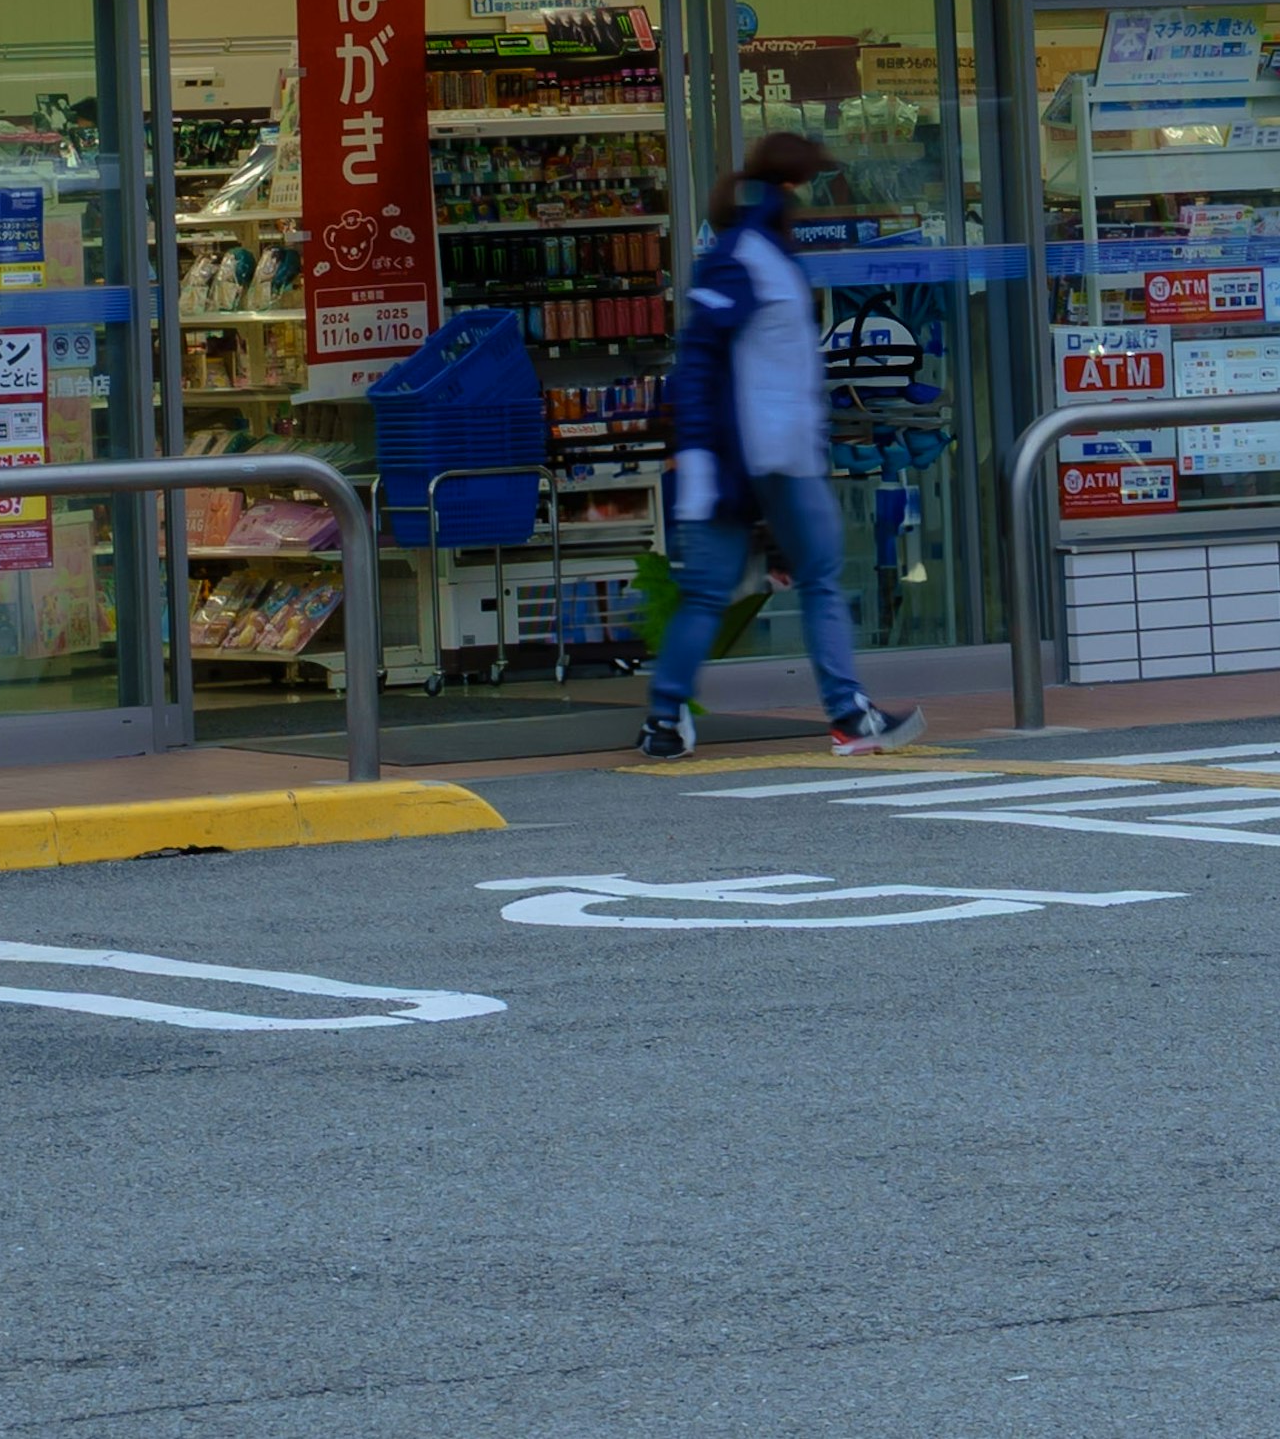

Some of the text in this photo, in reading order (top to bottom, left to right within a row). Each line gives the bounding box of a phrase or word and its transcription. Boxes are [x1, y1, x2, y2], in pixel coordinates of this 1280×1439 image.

[494, 0, 610, 13] 場合にはお酒を販売しません。
[1153, 16, 1257, 38] マチの本屋さん
[1171, 279, 1206, 295] ATM
[322, 308, 408, 325] 2024 2025
[1066, 328, 1159, 350] ローソン銀行
[1079, 355, 1151, 388] ATM
[1084, 472, 1119, 488] ATM
